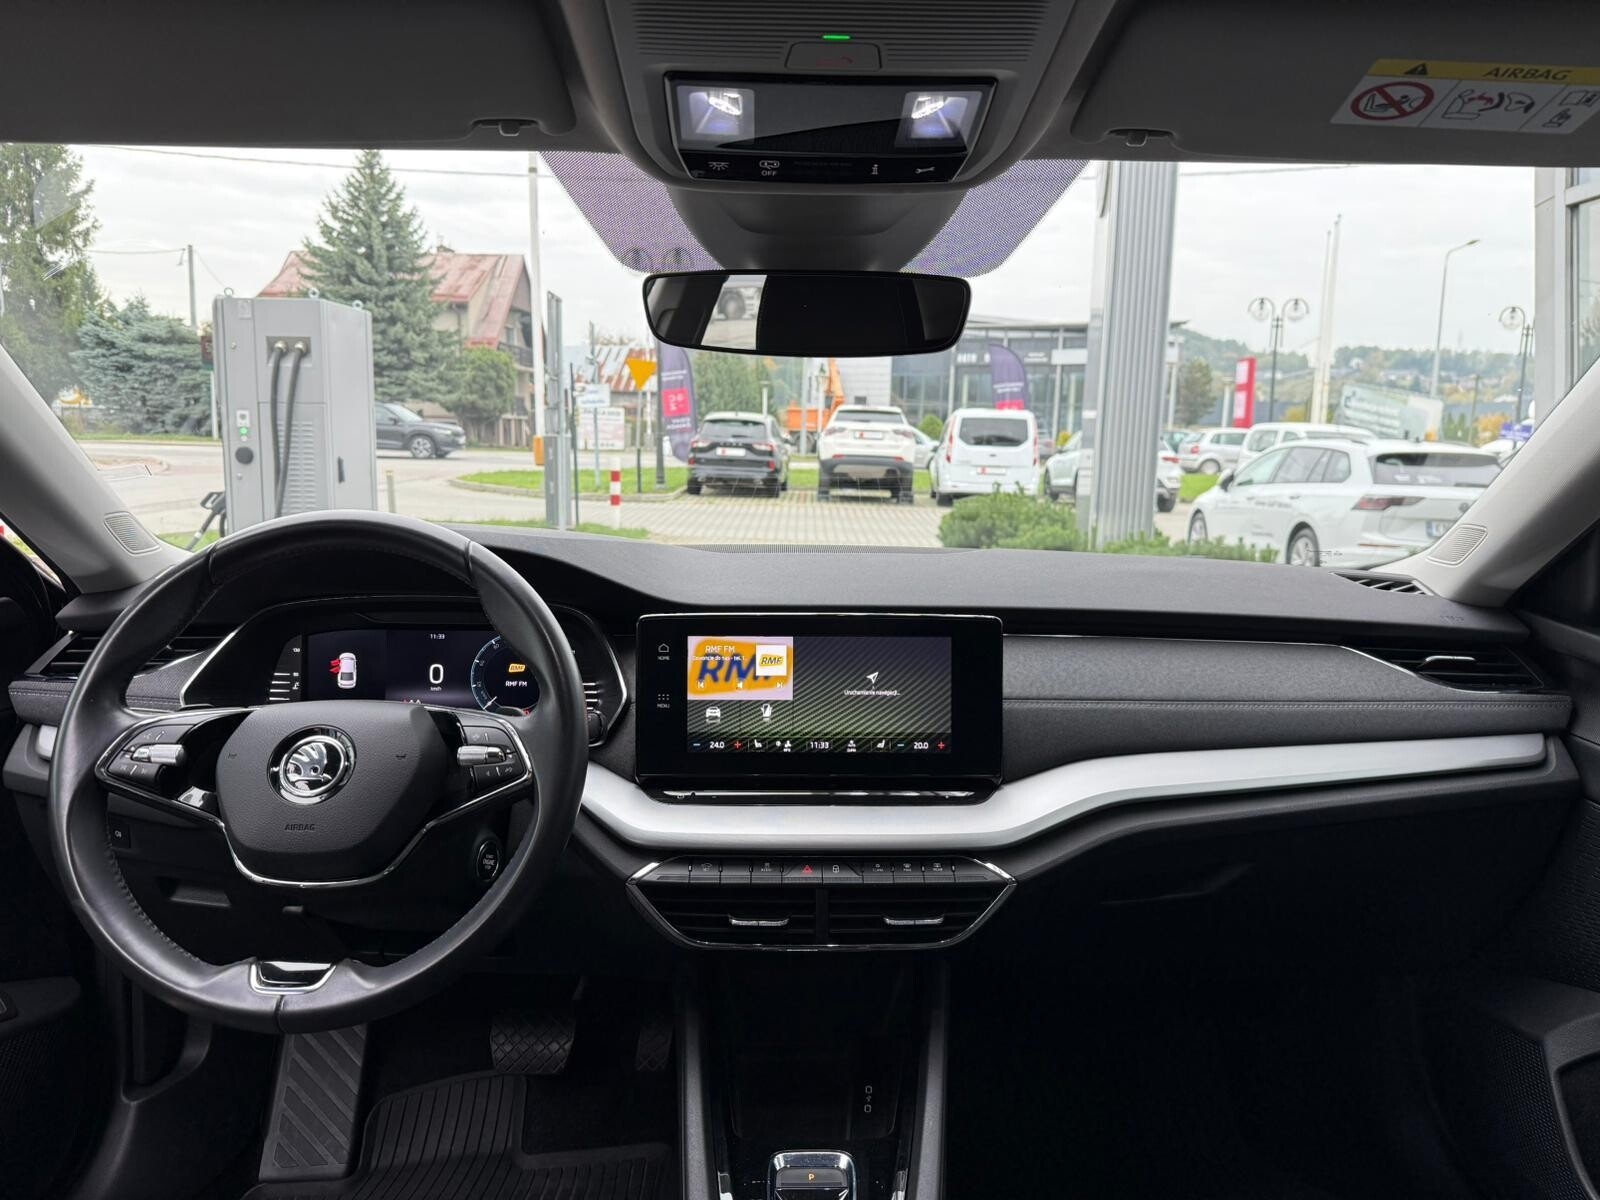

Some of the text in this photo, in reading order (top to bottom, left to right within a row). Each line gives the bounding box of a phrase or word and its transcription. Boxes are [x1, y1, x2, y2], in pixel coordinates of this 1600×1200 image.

[1483, 67, 1571, 81] AIRBAG
[705, 645, 736, 654] RMF FM
[761, 656, 783, 665] RMF
[429, 664, 444, 684] 0
[709, 741, 725, 749] 24.0
[810, 741, 829, 749] 11:33
[913, 741, 929, 749] 20.0
[808, 1173, 815, 1181] P
